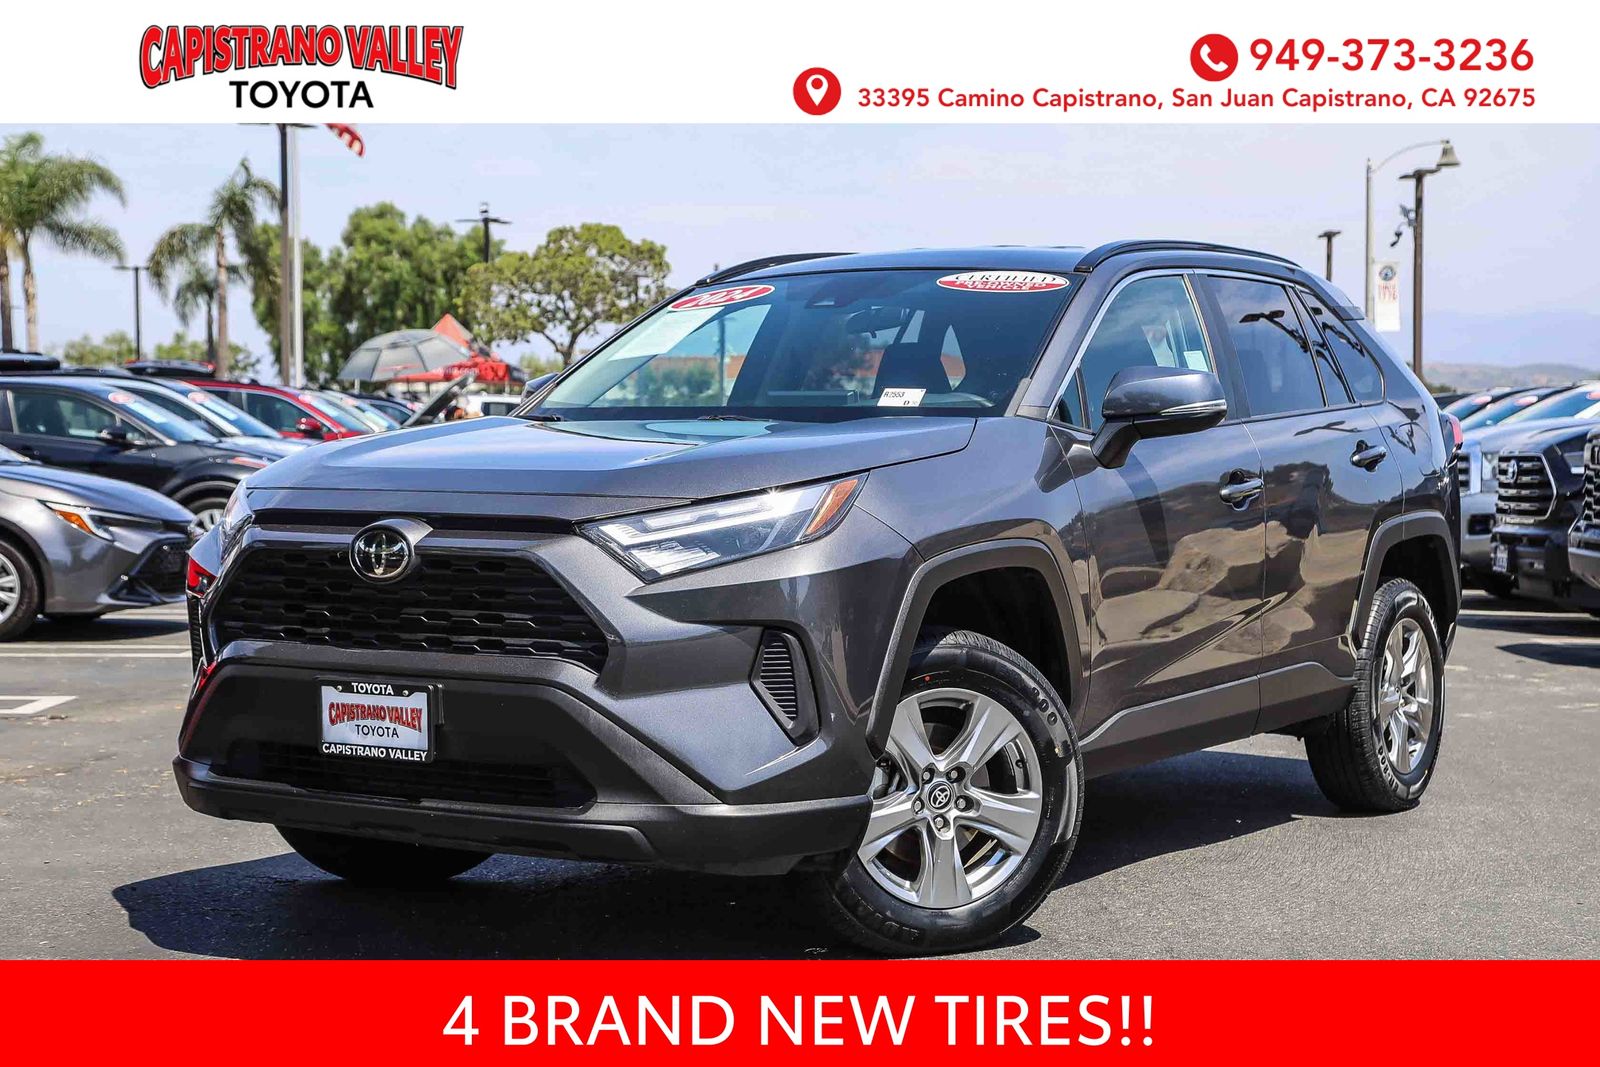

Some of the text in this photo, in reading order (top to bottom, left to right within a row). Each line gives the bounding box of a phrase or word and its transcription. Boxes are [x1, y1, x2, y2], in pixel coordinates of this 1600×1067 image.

[351, 682, 394, 696] TOYOTA
[328, 701, 423, 733] CAPISTRANO VALLEY
[355, 724, 400, 739] TOYOTA
[322, 743, 428, 762] CAPISTRANO VALLEY
